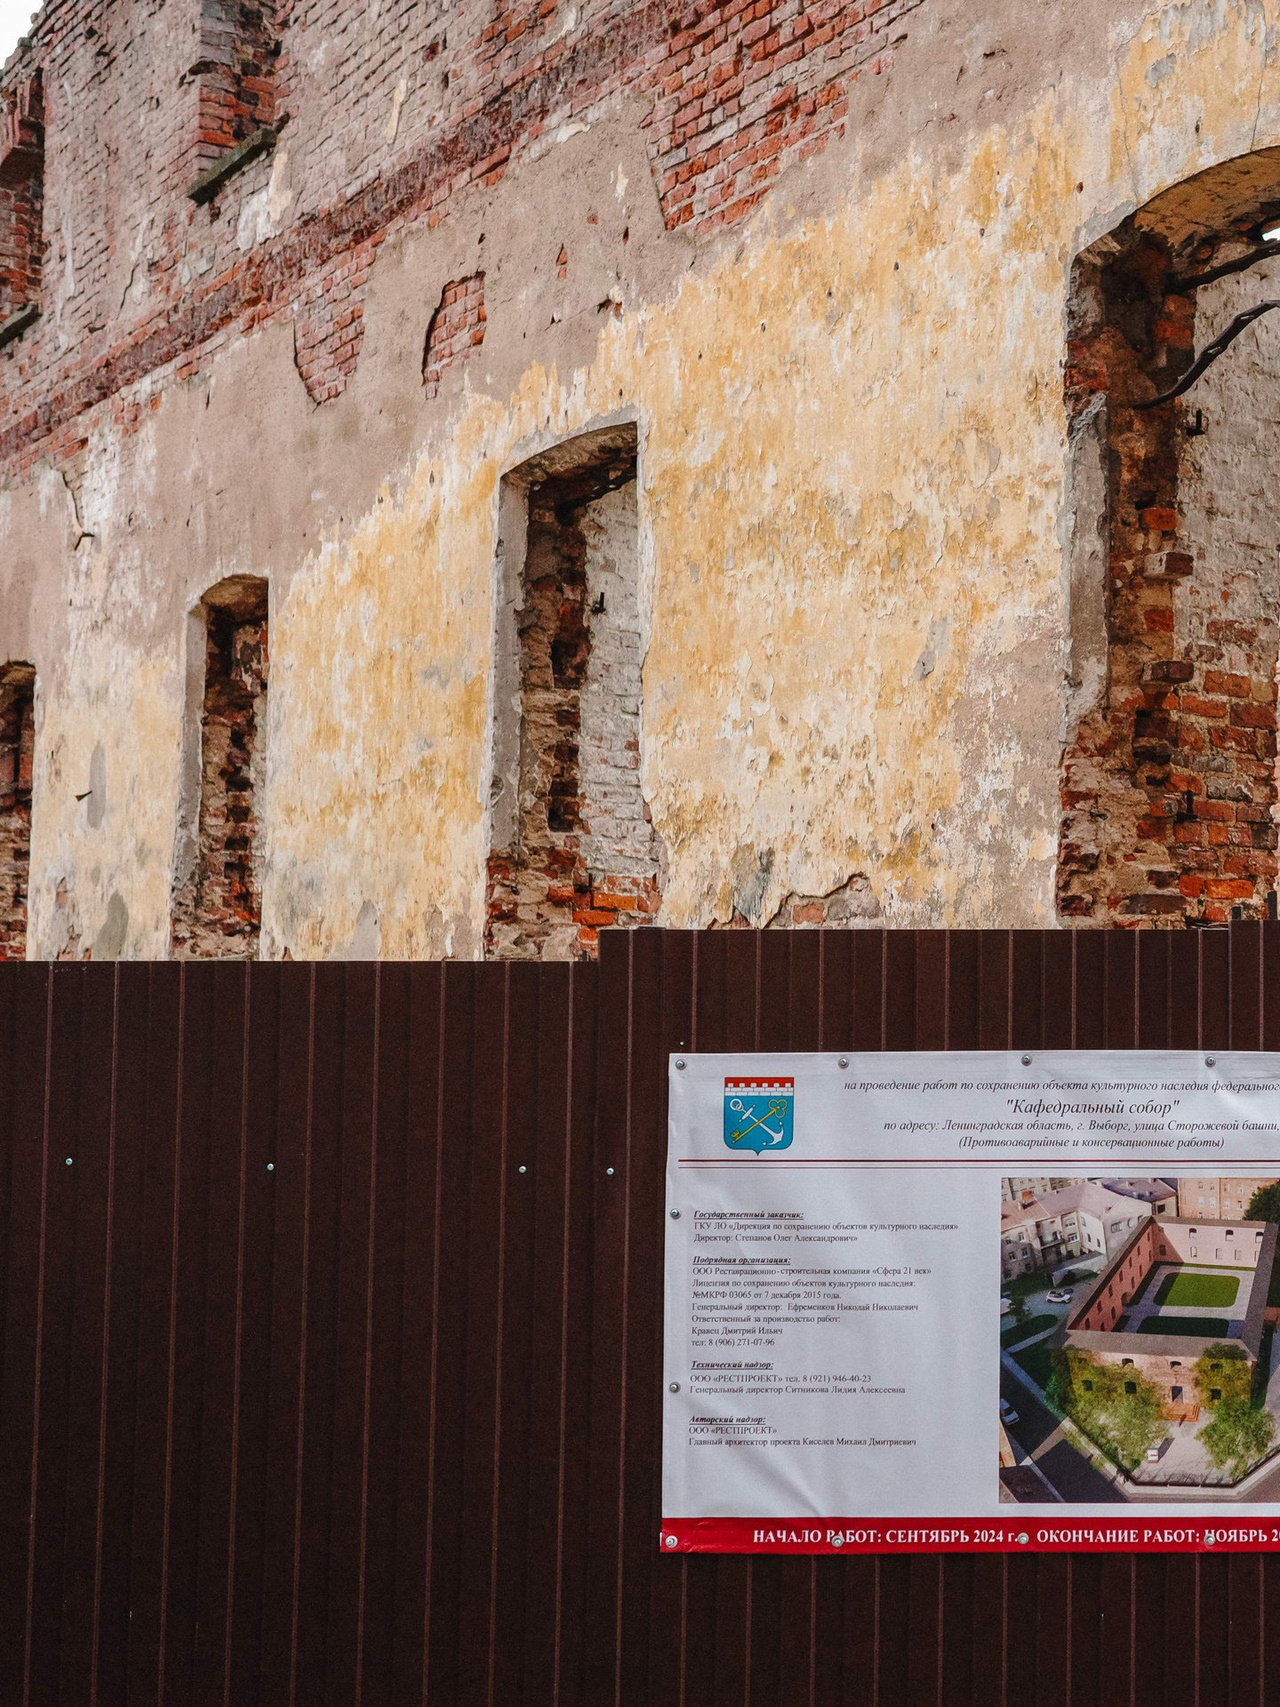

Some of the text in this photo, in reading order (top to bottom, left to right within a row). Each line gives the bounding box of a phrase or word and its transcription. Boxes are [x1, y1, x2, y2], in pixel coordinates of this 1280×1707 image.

[860, 1080, 920, 1091] проведение
[923, 1080, 958, 1091] работ
[961, 1082, 973, 1090] по
[977, 1082, 1039, 1093] сохранению
[1043, 1079, 1088, 1090] объекта
[1091, 1081, 1158, 1092] культурного
[1161, 1080, 1208, 1090] наследия
[1007, 1098, 1180, 1118] "Кафедральный собор"
[900, 1120, 939, 1133] адресу:
[942, 1120, 1023, 1133] Ленинградская
[1027, 1120, 1073, 1130] область,
[1089, 1120, 1130, 1133] Выборг,
[1133, 1124, 1164, 1133] улица
[1168, 1120, 1239, 1133] Сторожевой
[1242, 1120, 1279, 1130] башни,
[959, 1136, 1224, 1150] (Противоаварийные и консервационные работы)
[694, 1210, 764, 1218] Государственный
[729, 1222, 770, 1231] «Дирекция
[784, 1224, 830, 1232] сохранению
[832, 1222, 867, 1231] объектов
[870, 1224, 917, 1232] культурного
[694, 1234, 857, 1244] Директор: Степанов Олег Александрович»
[693, 1256, 736, 1264] Подрядная
[693, 1267, 712, 1275] ООО
[873, 1267, 901, 1277] «Сфера
[904, 1266, 911, 1275] 21
[692, 1279, 729, 1287] Лицензия
[829, 1281, 876, 1289] культурного
[765, 1290, 768, 1298] 7
[771, 1290, 800, 1300] декабря
[803, 1290, 821, 1298] 2015
[692, 1303, 742, 1312] Генеральный
[692, 1314, 751, 1322] Ответственный
[817, 1314, 840, 1324] работ:
[721, 1326, 756, 1336] Дмитрий
[759, 1326, 782, 1335] Ильич
[715, 1339, 734, 1347] (906)
[690, 1374, 711, 1382] ООО
[714, 1374, 782, 1383] «РЕСТПРОЕКТ»
[803, 1374, 807, 1382] 8
[810, 1374, 830, 1383] (921)
[833, 1374, 871, 1383] 946-40-23
[690, 1385, 905, 1395] Генеральный директор Ситникова Лидия Алексеевна
[689, 1416, 766, 1424] Авторский надзор:
[689, 1437, 722, 1446] Главный
[725, 1439, 768, 1447] архитектор
[770, 1439, 800, 1447] проекта
[837, 1437, 866, 1445] Михаил
[869, 1437, 916, 1447] Дмитриевич
[754, 1529, 821, 1543] НАЧАЛО
[886, 1530, 969, 1543] СЕНТЯБРЬ
[974, 1529, 1003, 1542] 2024
[1037, 1529, 1138, 1542] ОКОНЧАНИЕ
[1144, 1529, 1199, 1542] РАБОТ:
